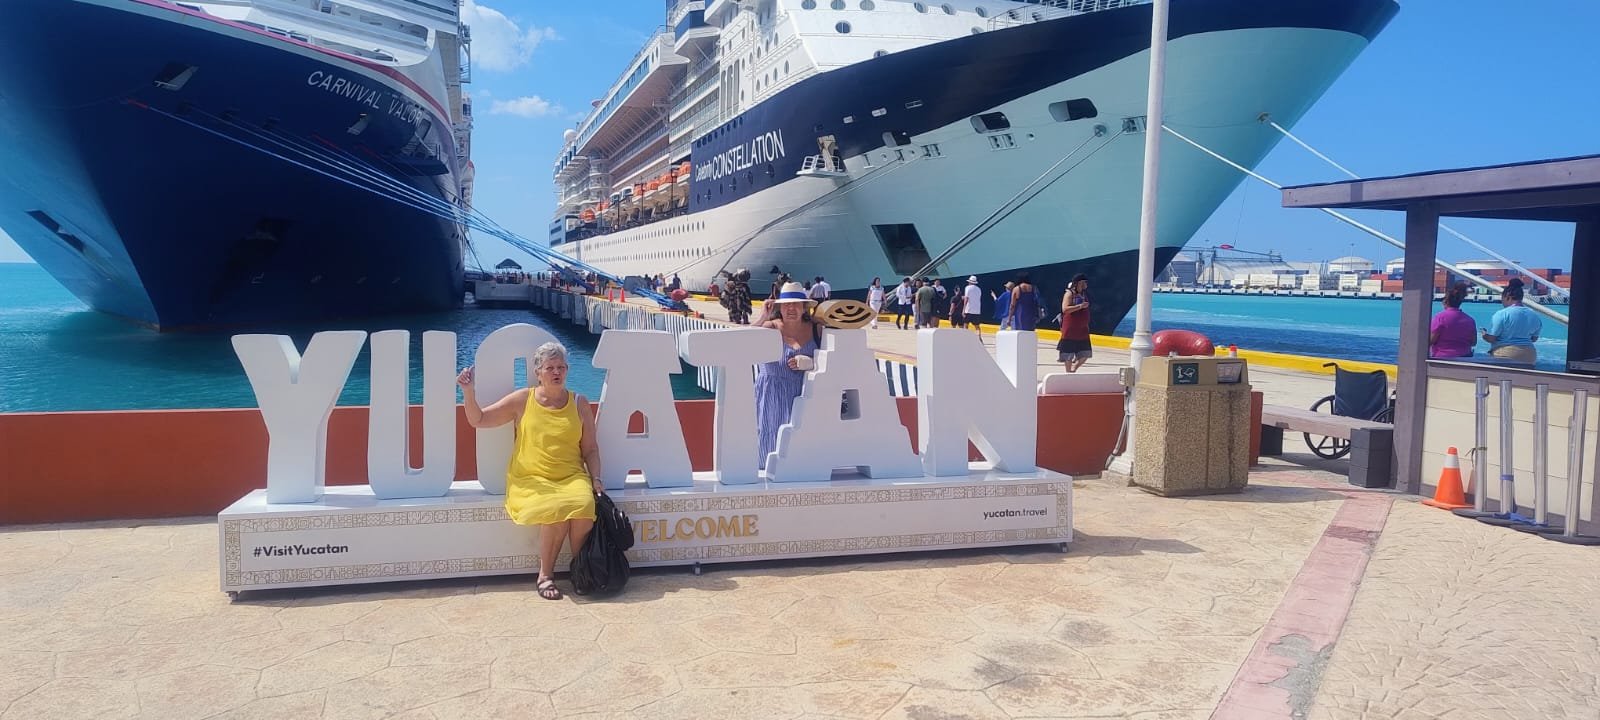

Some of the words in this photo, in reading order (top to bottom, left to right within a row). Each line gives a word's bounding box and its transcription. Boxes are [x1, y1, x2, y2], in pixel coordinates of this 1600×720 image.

[307, 71, 381, 109] CARNIVAL
[388, 97, 421, 127] VALOR
[712, 128, 785, 180] CONSTELLATION
[983, 508, 1047, 520] yucatan.travel
[253, 544, 348, 557] #VisitYucatan
